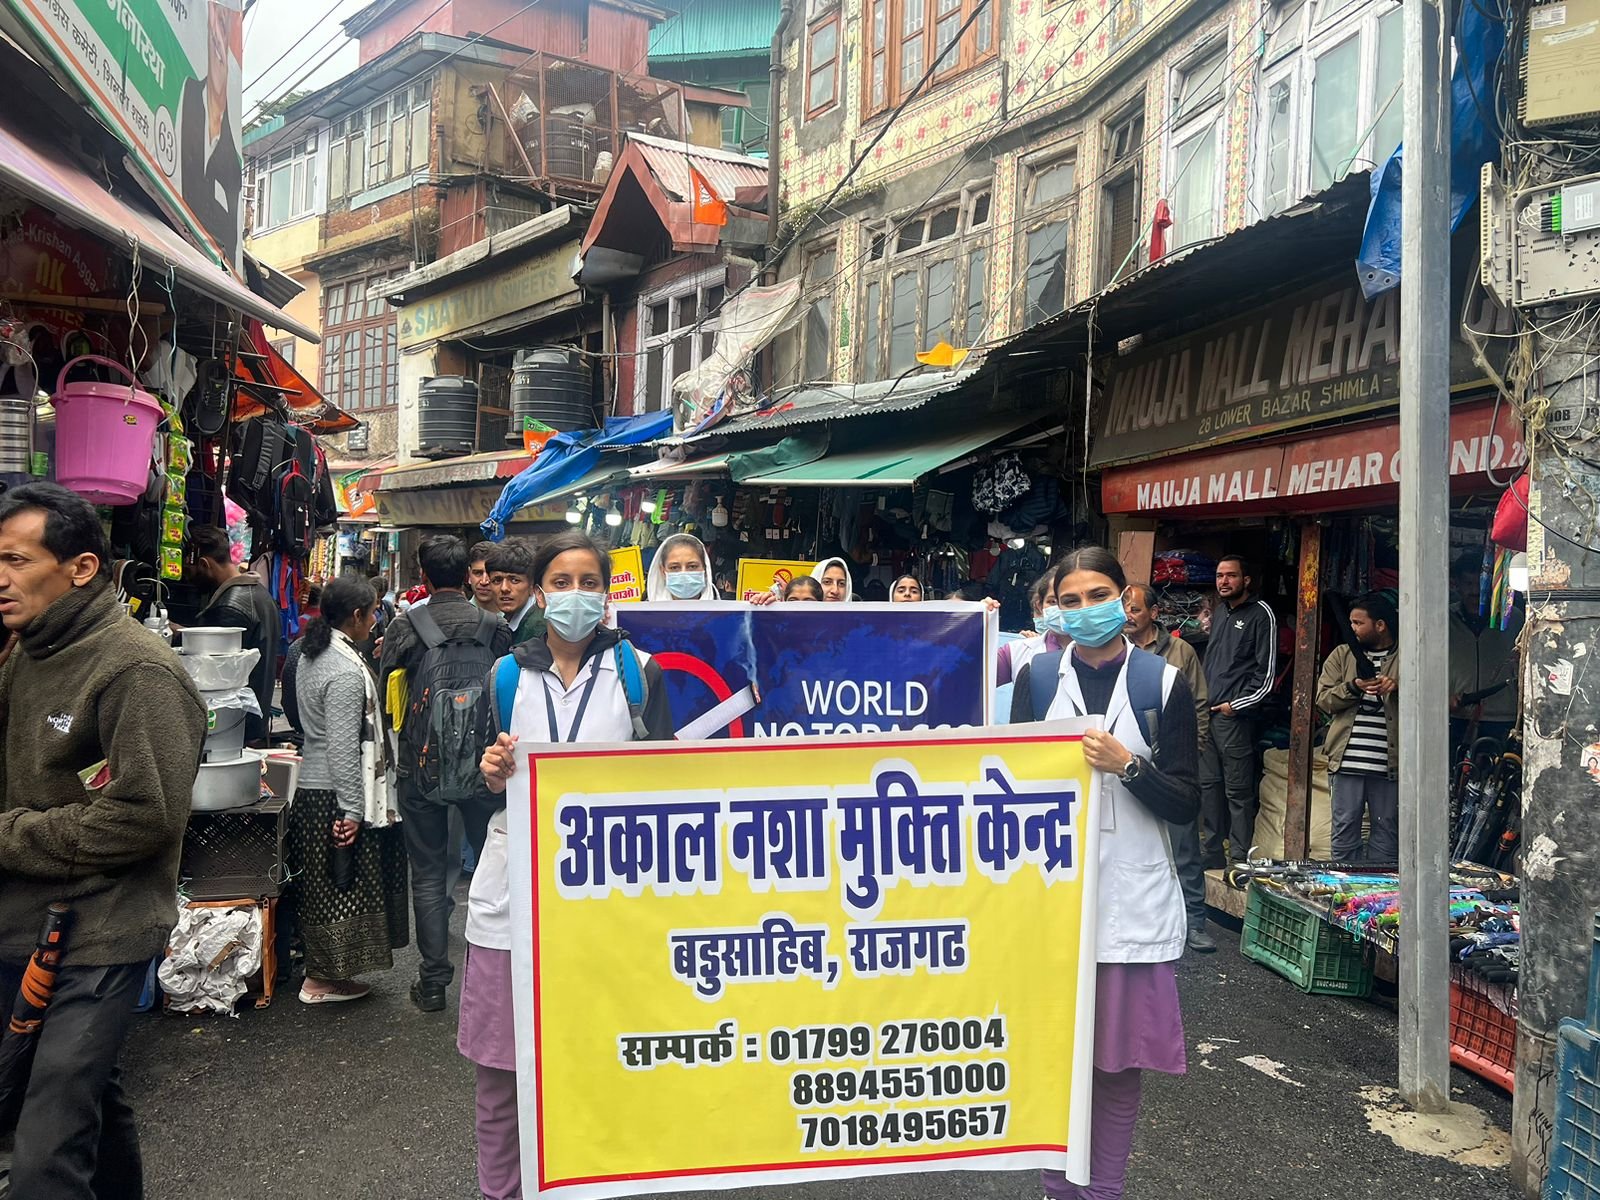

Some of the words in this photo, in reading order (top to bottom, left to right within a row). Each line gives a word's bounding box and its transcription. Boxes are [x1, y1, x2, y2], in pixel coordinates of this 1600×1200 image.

[157, 121, 174, 163] 63
[415, 283, 498, 337] SAATVIK
[501, 267, 559, 305] SWEETS
[1104, 350, 1190, 437] MAUJA
[1196, 319, 1271, 416] MALL
[1279, 286, 1400, 389] MEHA
[1199, 418, 1212, 435] 28
[1214, 404, 1251, 429] LOWER
[1262, 390, 1311, 419] BAZAR
[1137, 476, 1201, 511] MAUJA
[1207, 467, 1278, 504] MALL
[1287, 451, 1384, 496] MEHAR
[801, 680, 929, 717] WORLD
[559, 801, 721, 887] अकाल
[729, 797, 828, 881] नशा
[837, 770, 964, 909] मुक्ति
[973, 768, 1076, 873] केन्द्र
[848, 924, 966, 973] राजगढ
[621, 1022, 735, 1067] सम्पर्क
[770, 1026, 870, 1061] 01799
[881, 1018, 1005, 1054] 276004
[793, 1061, 1006, 1106] 8894551000
[801, 1105, 1007, 1148] 7018495657
